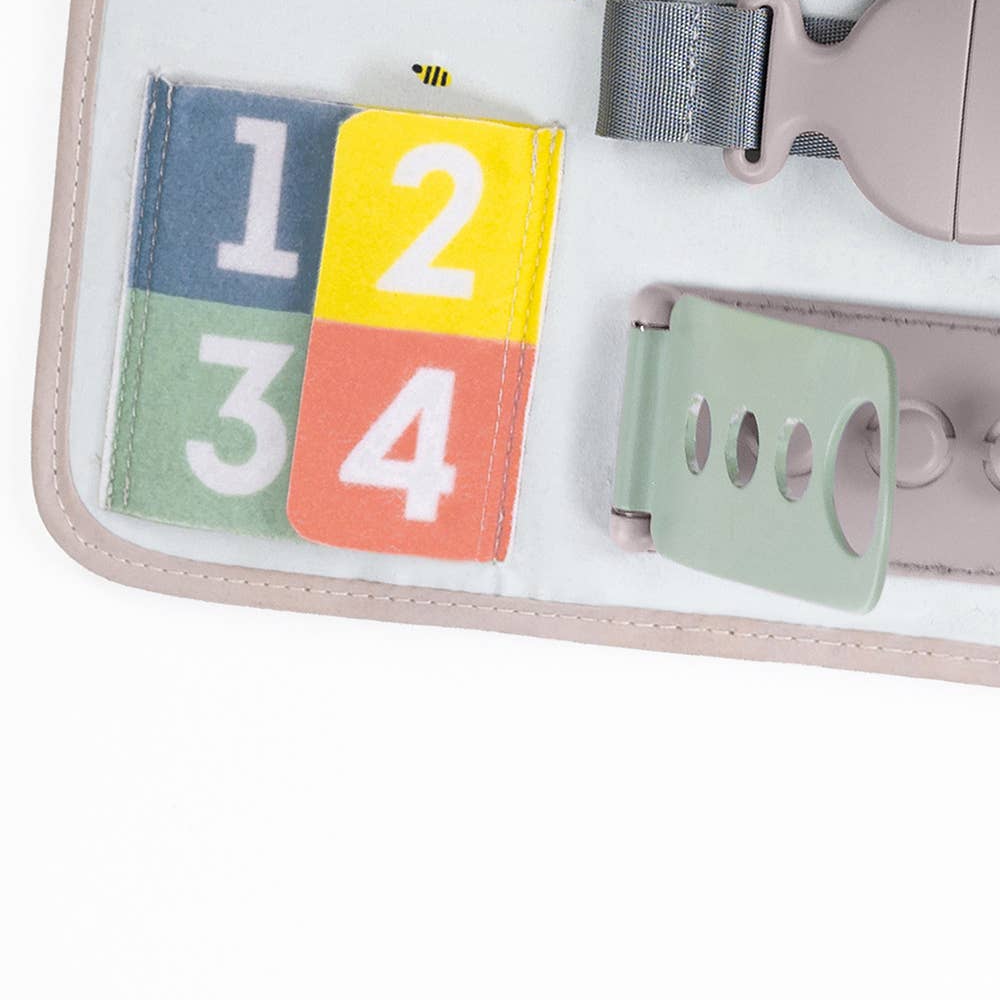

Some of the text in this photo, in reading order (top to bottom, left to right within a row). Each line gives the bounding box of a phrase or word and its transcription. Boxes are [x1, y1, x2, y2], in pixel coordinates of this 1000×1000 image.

[217, 116, 299, 279] 1
[376, 142, 484, 300] 2
[185, 333, 295, 496] 3
[338, 366, 458, 523] 4
